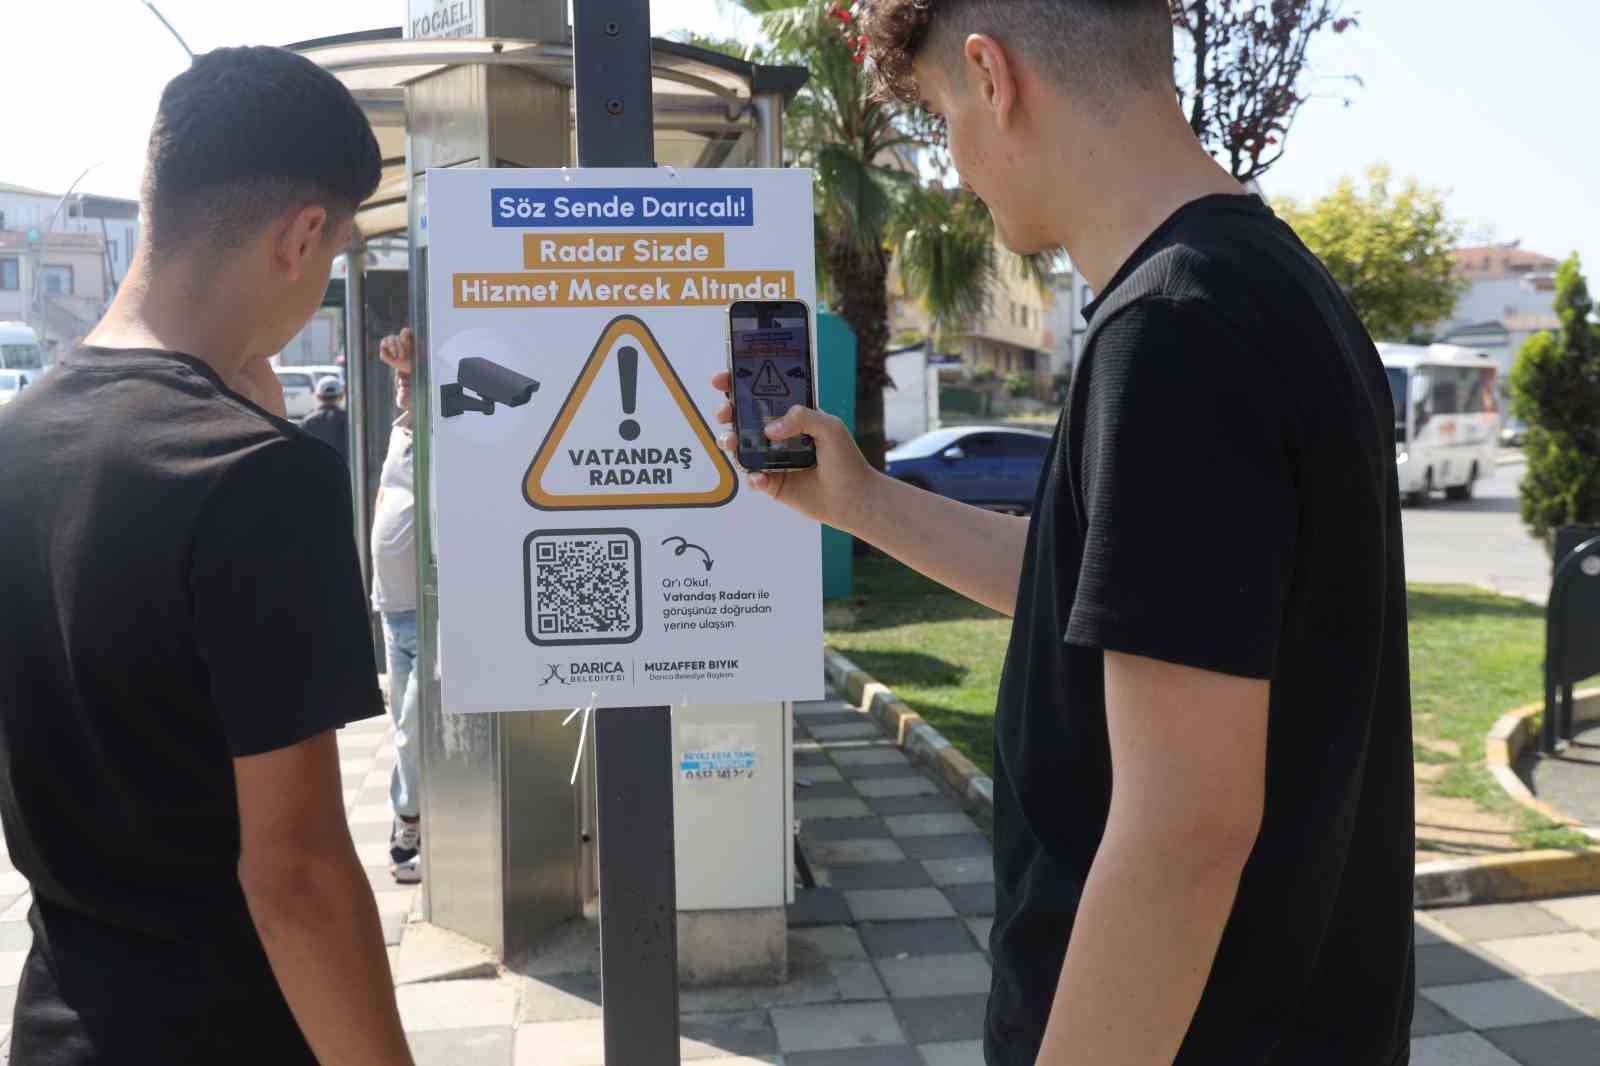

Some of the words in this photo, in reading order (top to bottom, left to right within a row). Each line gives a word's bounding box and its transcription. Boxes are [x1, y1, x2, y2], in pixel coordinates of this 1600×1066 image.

[499, 195, 546, 218] Söz
[554, 195, 635, 218] Sende
[642, 194, 746, 217] Darıcalı!
[539, 238, 624, 263] Radar
[633, 237, 709, 262] Sizde
[461, 279, 559, 302] Hizmet
[567, 277, 671, 301] Mercek
[679, 275, 788, 300] Altında!
[568, 447, 692, 470] VATANDAŞ
[589, 468, 673, 486] RADARI
[663, 591, 716, 602] Vatandaş
[719, 590, 756, 600] Radarı
[757, 588, 770, 599] ile
[662, 606, 718, 619] görüşünüz
[719, 604, 772, 616] doğrudan
[663, 621, 697, 632] yerine
[570, 661, 624, 675] DARICA
[644, 660, 706, 672] MUZAFFER
[708, 659, 739, 670] BIYIK
